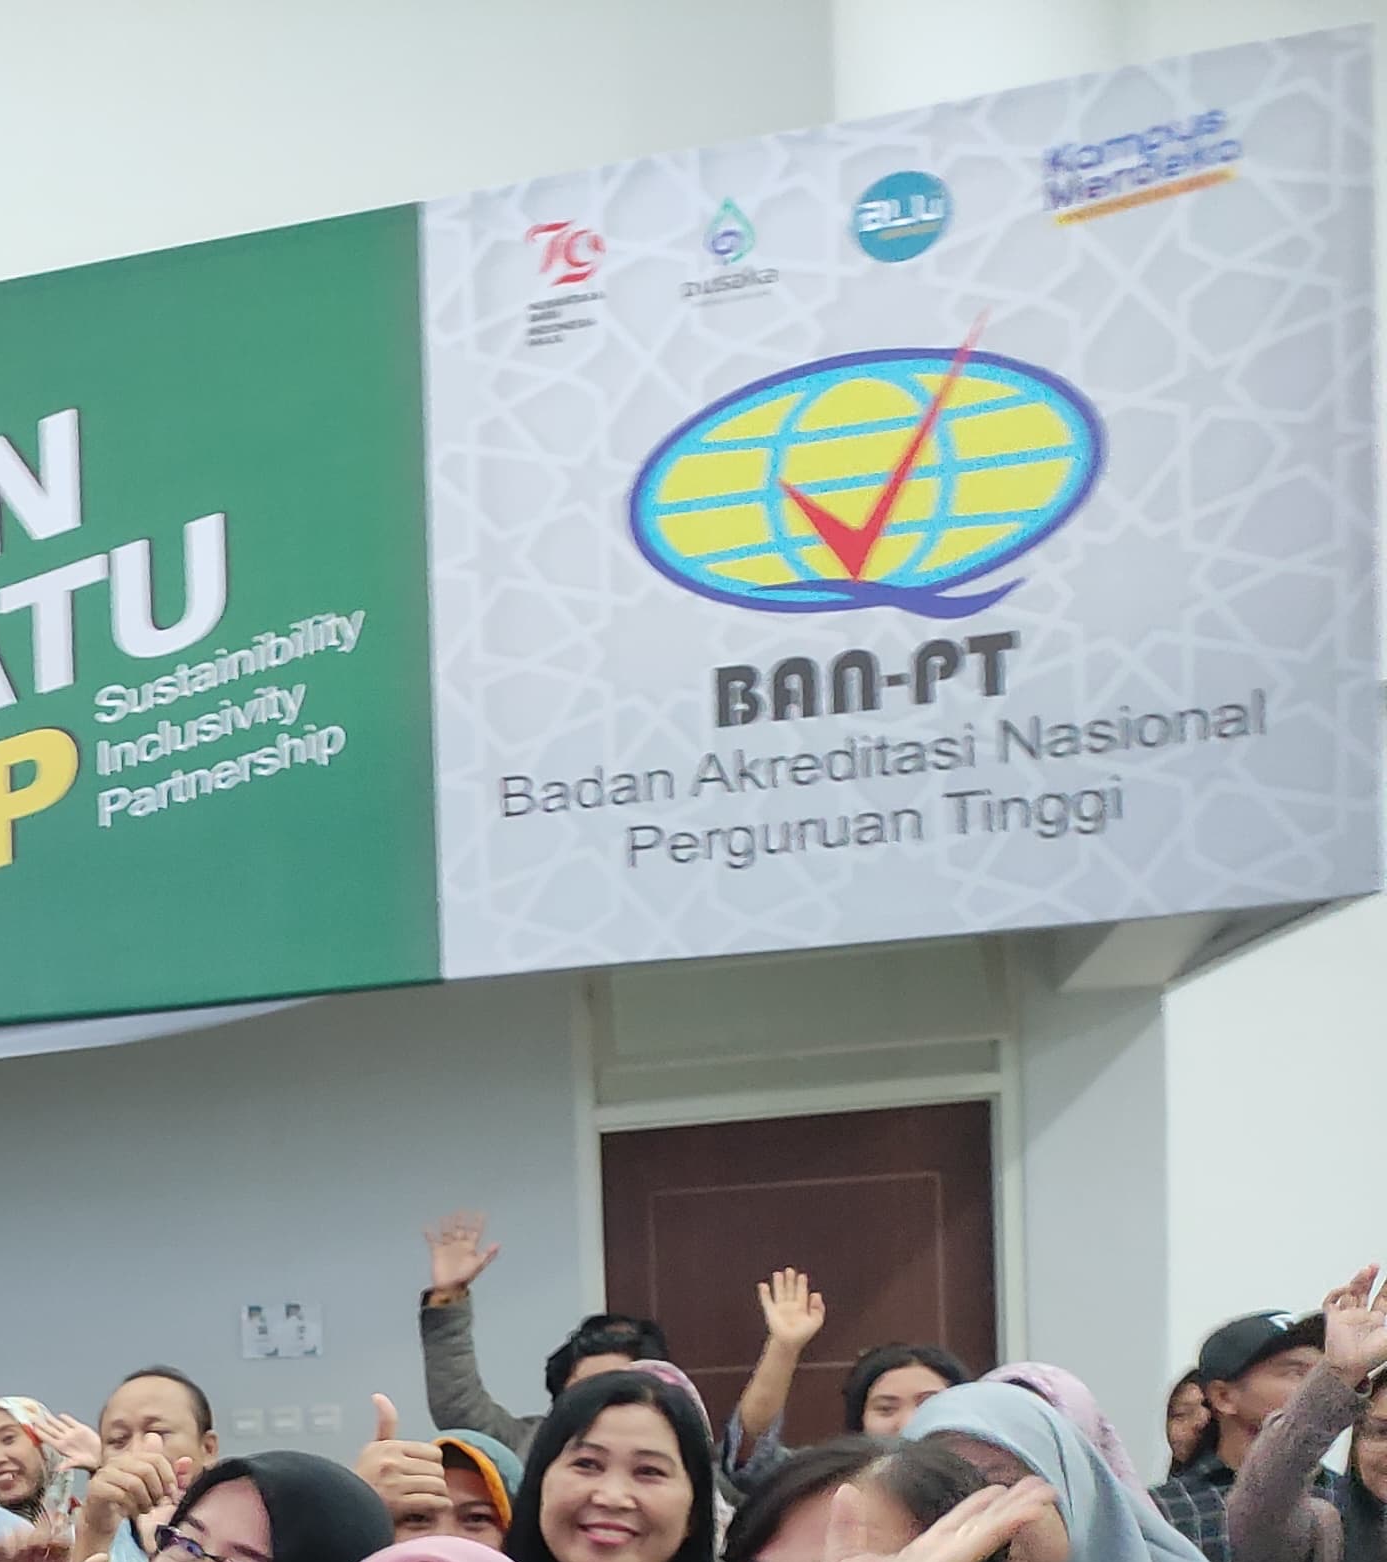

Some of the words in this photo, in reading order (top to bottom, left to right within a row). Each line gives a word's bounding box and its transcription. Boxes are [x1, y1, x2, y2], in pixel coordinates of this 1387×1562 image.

[714, 630, 1021, 727] BAN-PT
[96, 684, 306, 776] Inclusivity
[98, 723, 346, 827] Partnership
[500, 766, 675, 818] Badan
[695, 724, 976, 796] Akreditasi
[999, 689, 1266, 760] Nasional
[627, 807, 924, 868] Perguruan
[945, 776, 1125, 839] Tinggi
